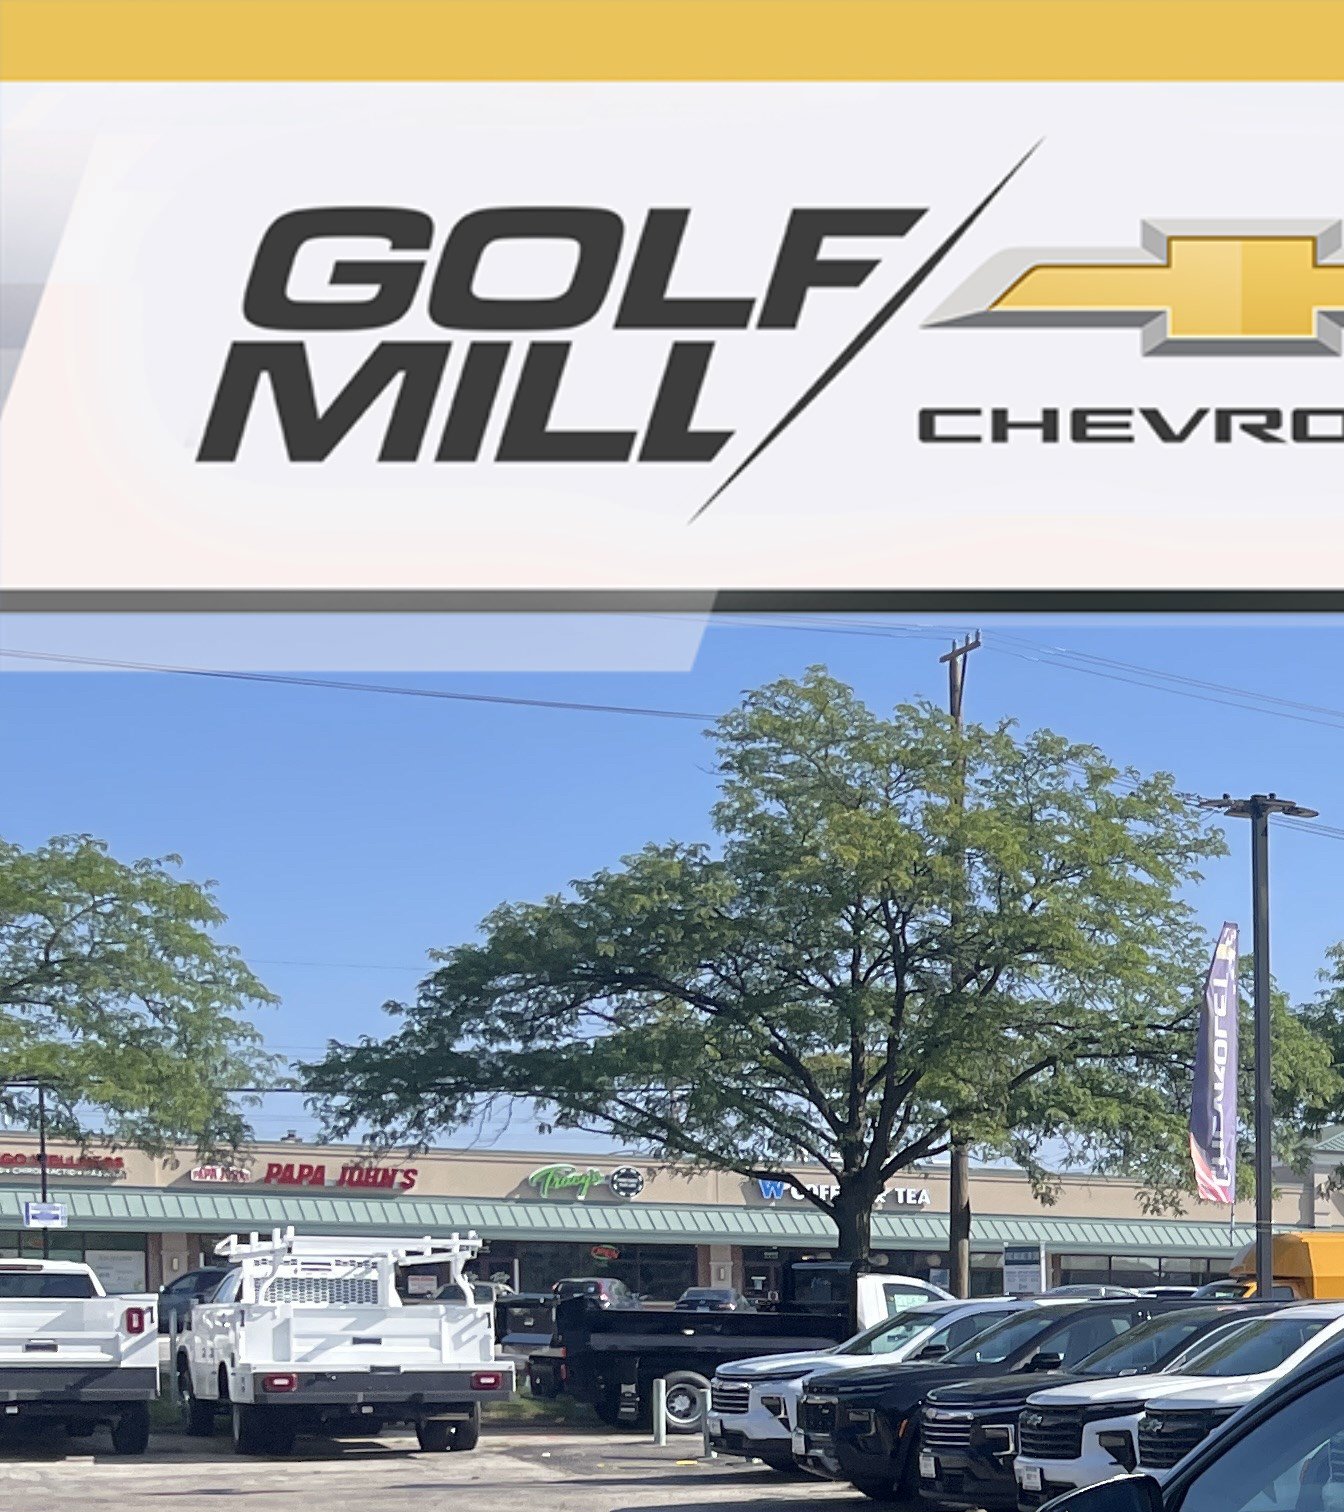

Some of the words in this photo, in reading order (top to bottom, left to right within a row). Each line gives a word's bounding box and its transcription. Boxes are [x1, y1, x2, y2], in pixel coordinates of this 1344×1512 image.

[264, 1163, 326, 1185] PAPA
[336, 1166, 418, 1190] JOHN'S
[894, 1187, 931, 1205] TEA
